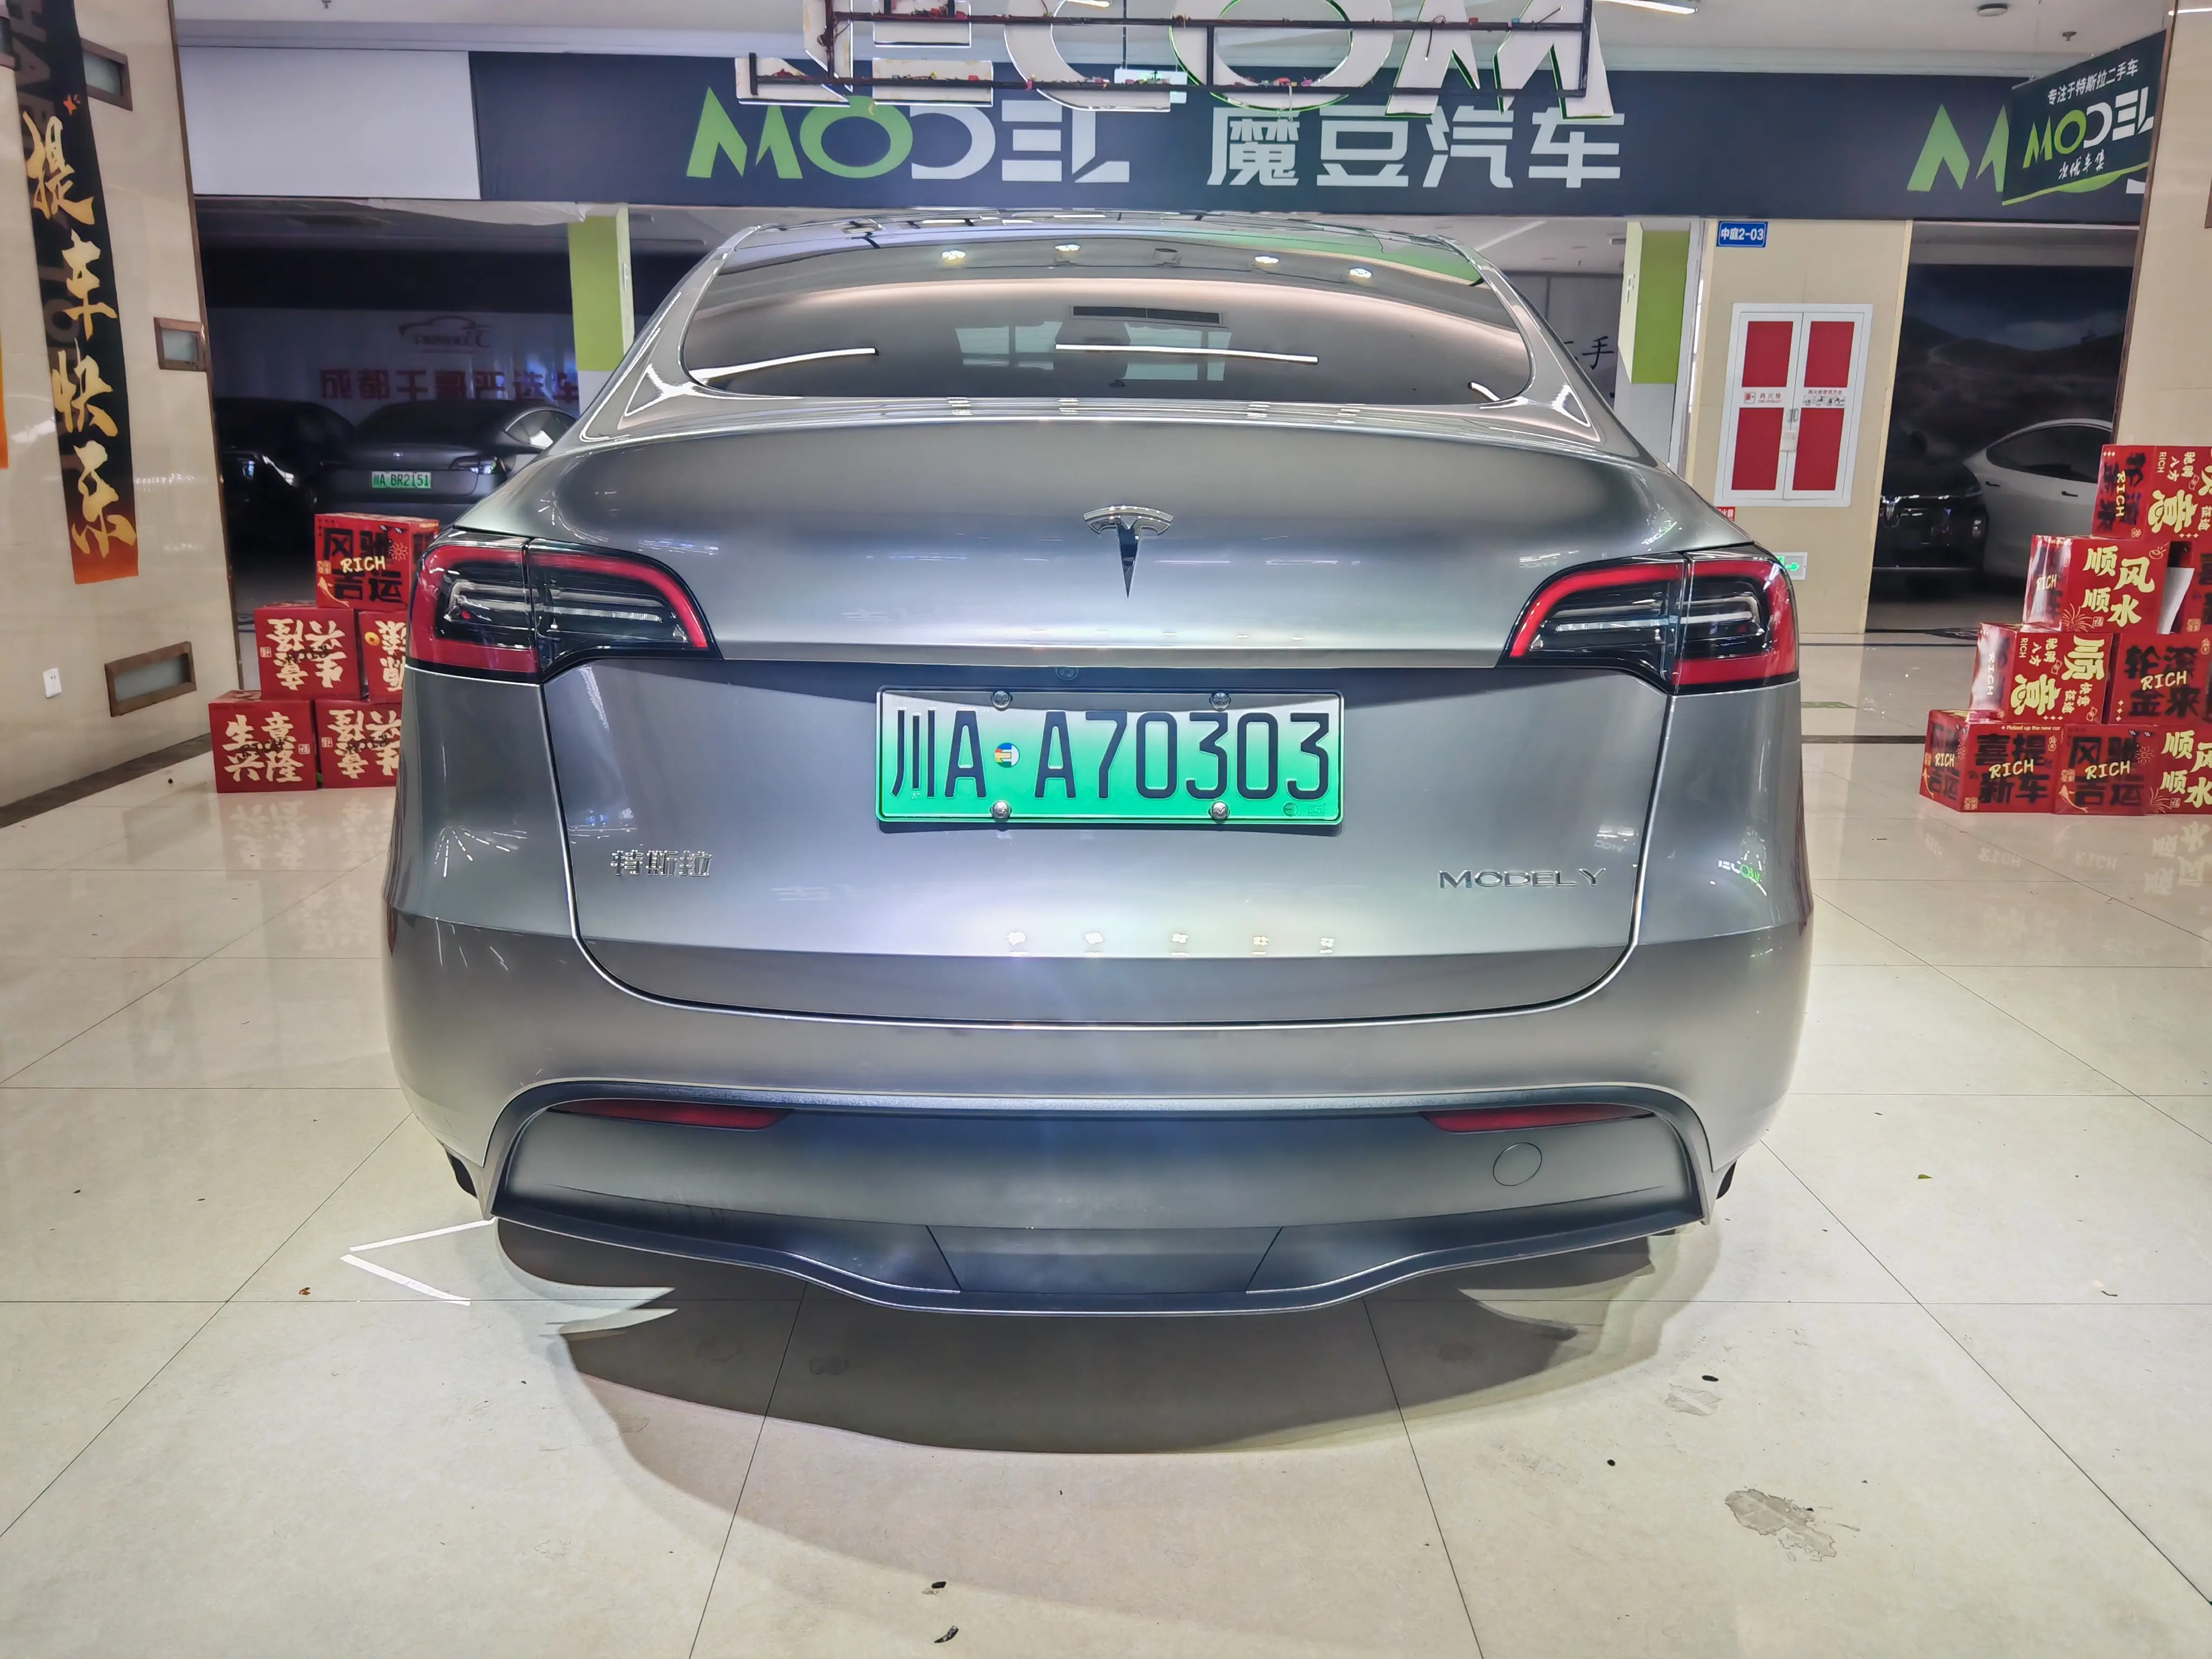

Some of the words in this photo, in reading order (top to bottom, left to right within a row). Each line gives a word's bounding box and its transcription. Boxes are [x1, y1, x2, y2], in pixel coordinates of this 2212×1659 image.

[2048, 59, 2139, 105] 专注于特斯拉二手车
[686, 86, 1130, 183] MODEL
[2022, 86, 2154, 168] MODEL
[1207, 106, 1624, 188] 魔豆汽车
[1721, 227, 1764, 241] 中庭2-03
[23, 112, 137, 557] 提车快乐
[2157, 451, 2167, 473] RICH
[2167, 456, 2180, 482] 八方
[2115, 470, 2126, 517] RICH
[340, 555, 386, 573] RICH
[2036, 574, 2057, 591] RICH
[2019, 638, 2028, 658] RICH
[2028, 642, 2042, 666] 八方
[1986, 652, 1995, 696] RICH
[2140, 670, 2182, 691] RICH
[891, 708, 987, 798] 川A
[1034, 710, 1330, 800] A70303
[1935, 752, 1955, 767] RICH
[1989, 759, 2034, 779] RICH
[2085, 760, 2130, 780] RICH
[610, 849, 712, 877] 特斯拉
[1438, 869, 1577, 888] MODEL
[1577, 867, 1607, 887] Y
